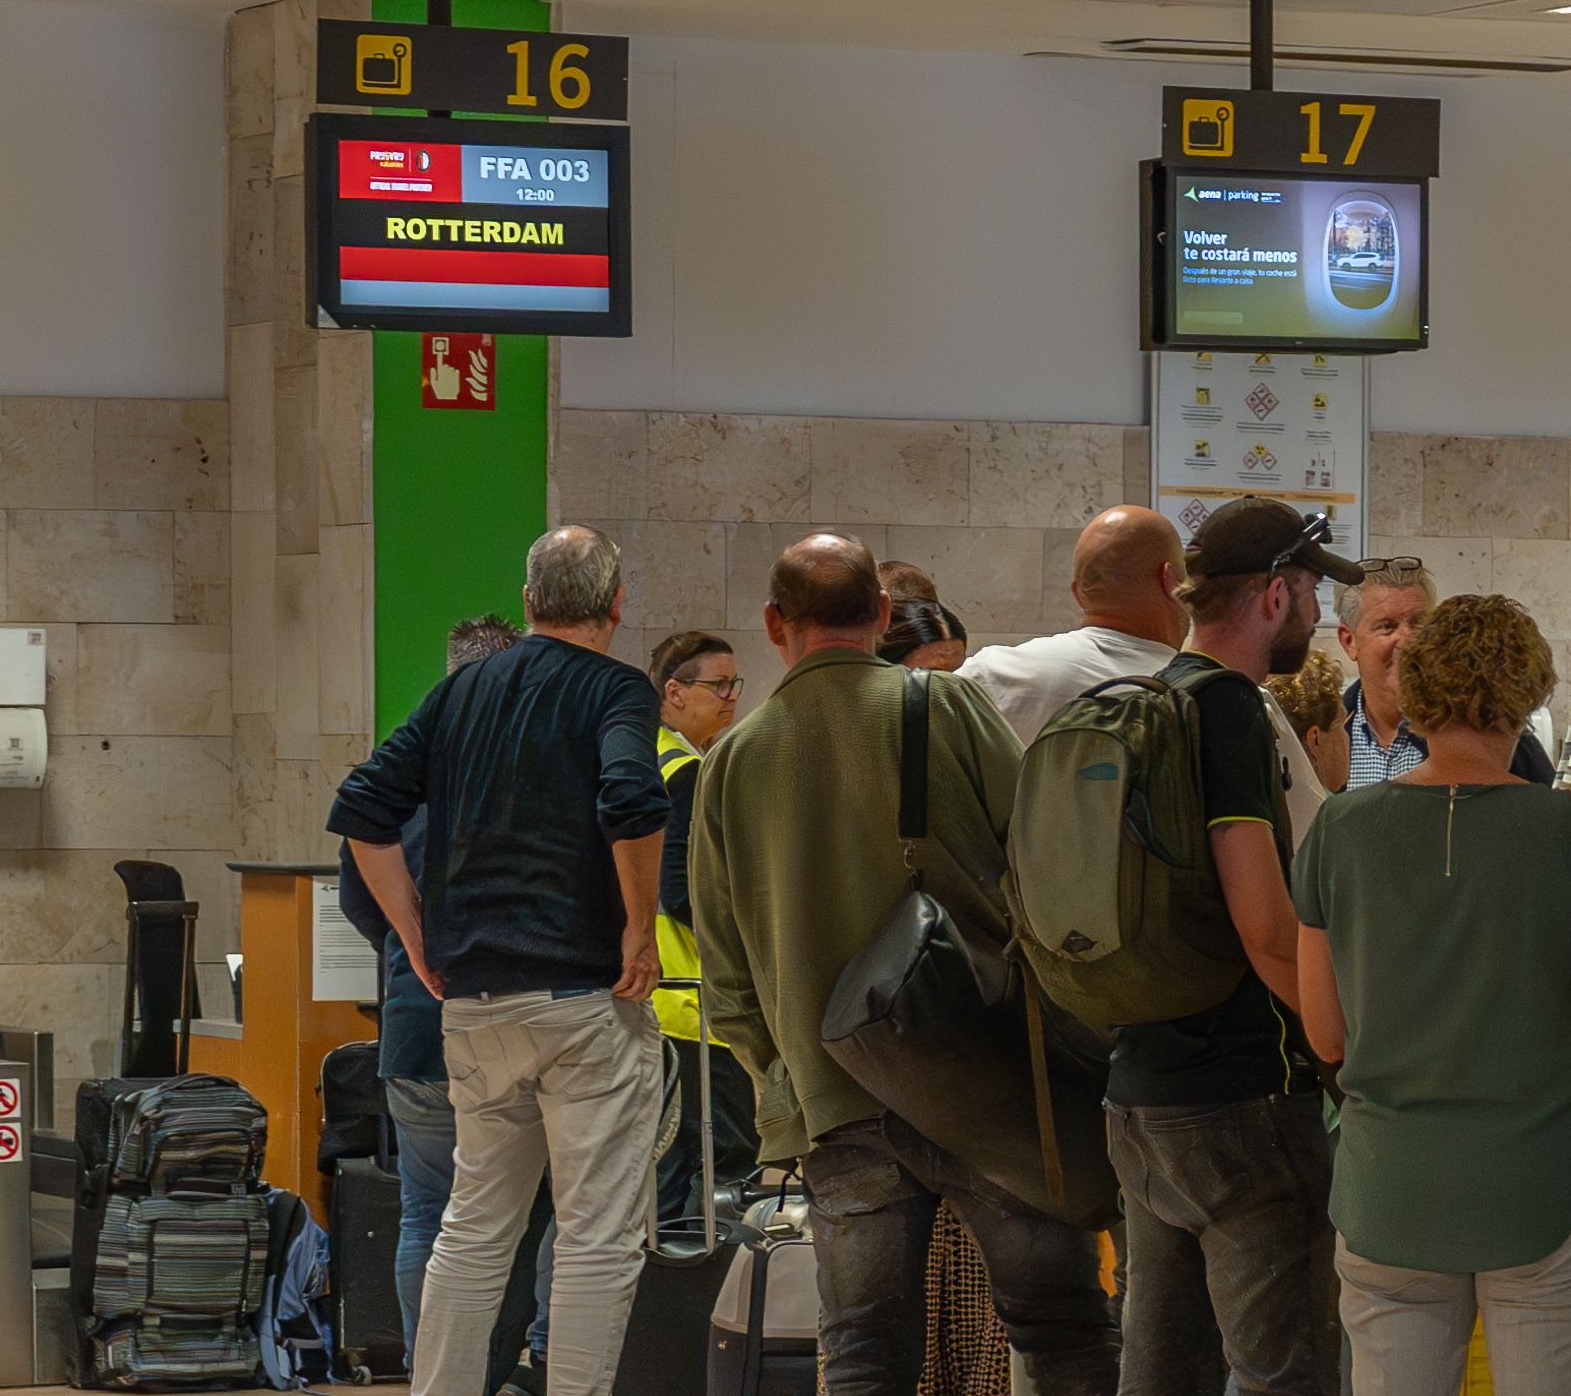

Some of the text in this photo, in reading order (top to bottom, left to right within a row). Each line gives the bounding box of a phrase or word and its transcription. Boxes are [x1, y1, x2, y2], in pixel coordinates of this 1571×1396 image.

[506, 40, 591, 109] 16
[1299, 101, 1377, 166] 17
[480, 156, 590, 182] FFA 003
[516, 188, 555, 202] 12:00
[1198, 190, 1222, 199] aena
[1227, 190, 1260, 203] parking
[386, 217, 564, 245] ROTTERDAM
[1183, 231, 1228, 245] Volver
[1183, 247, 1298, 263] te costará menos
